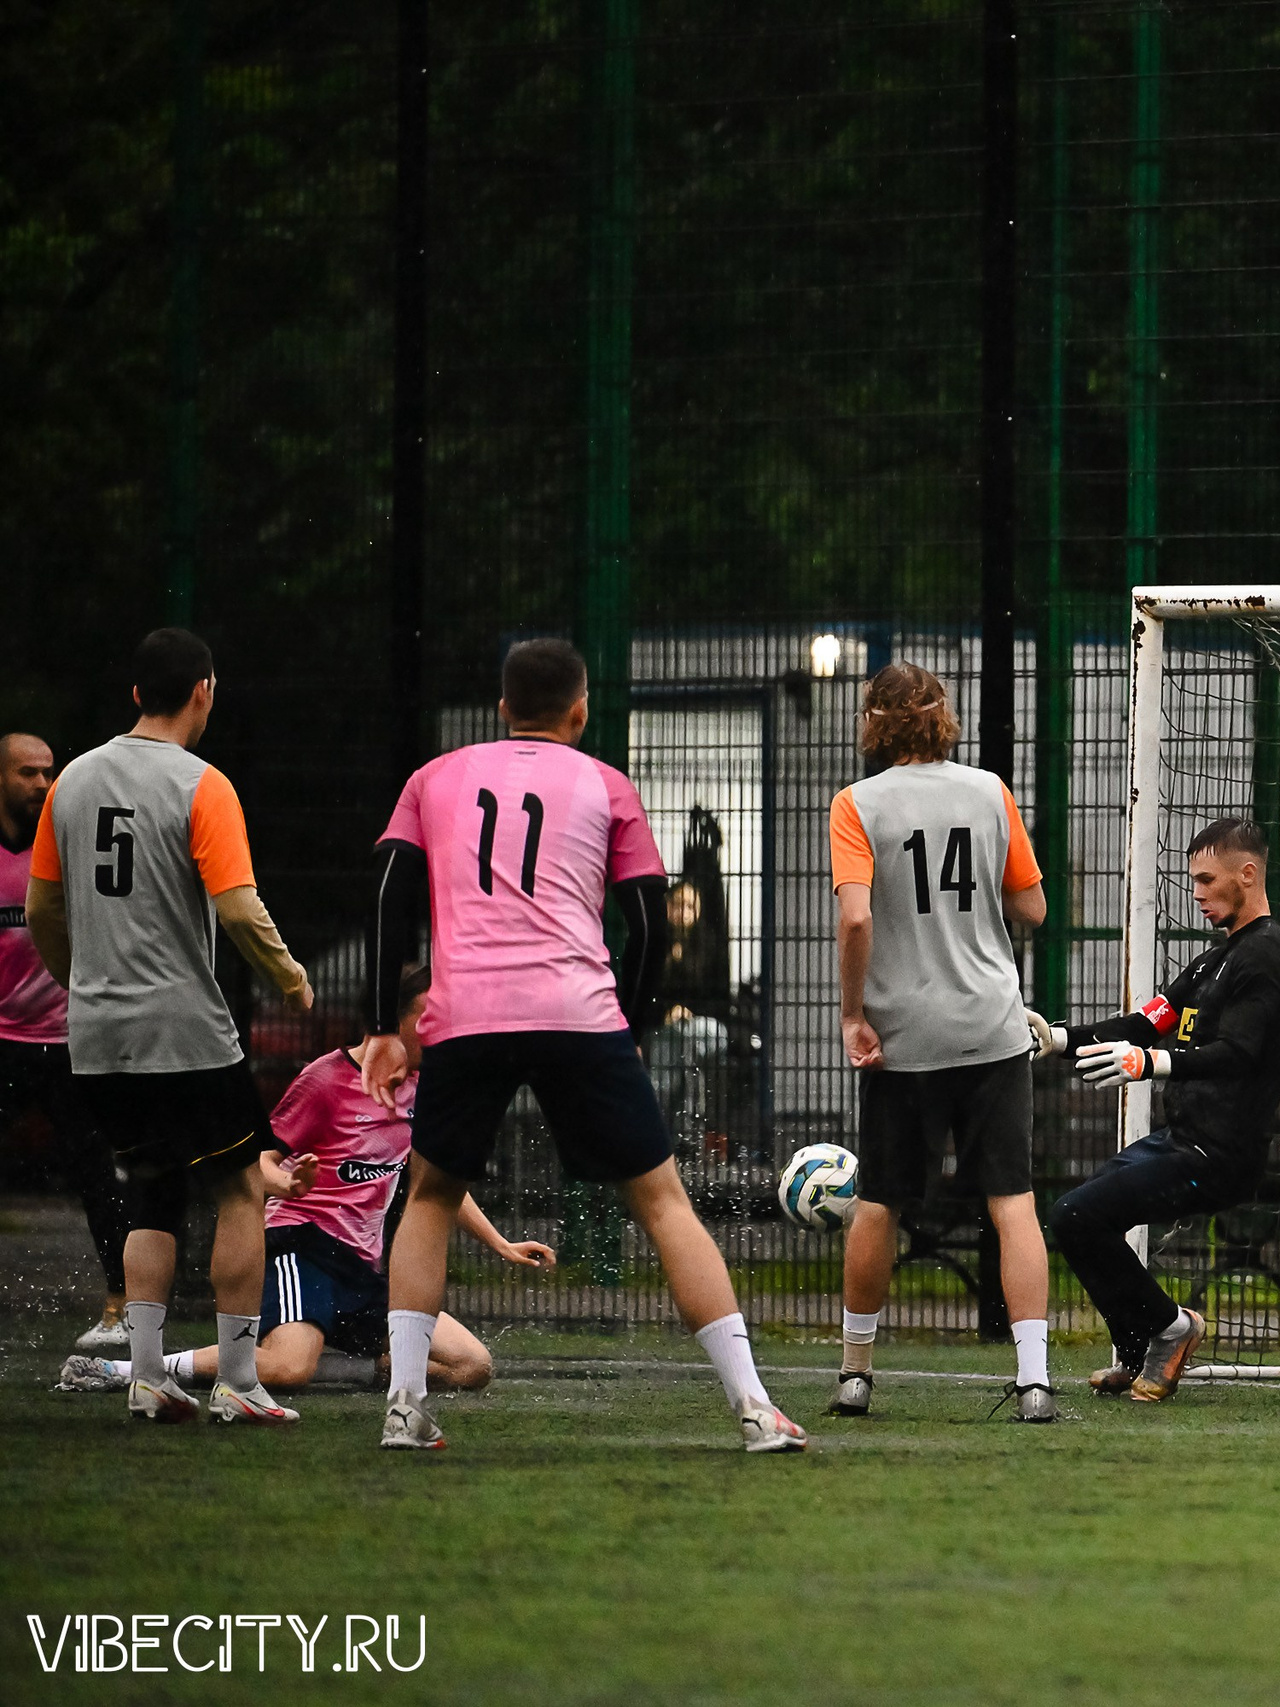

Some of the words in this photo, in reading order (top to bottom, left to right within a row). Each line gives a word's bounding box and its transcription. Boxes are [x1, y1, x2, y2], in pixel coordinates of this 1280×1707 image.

[95, 806, 135, 897] 5
[476, 787, 544, 899] 11
[903, 827, 976, 914] 14
